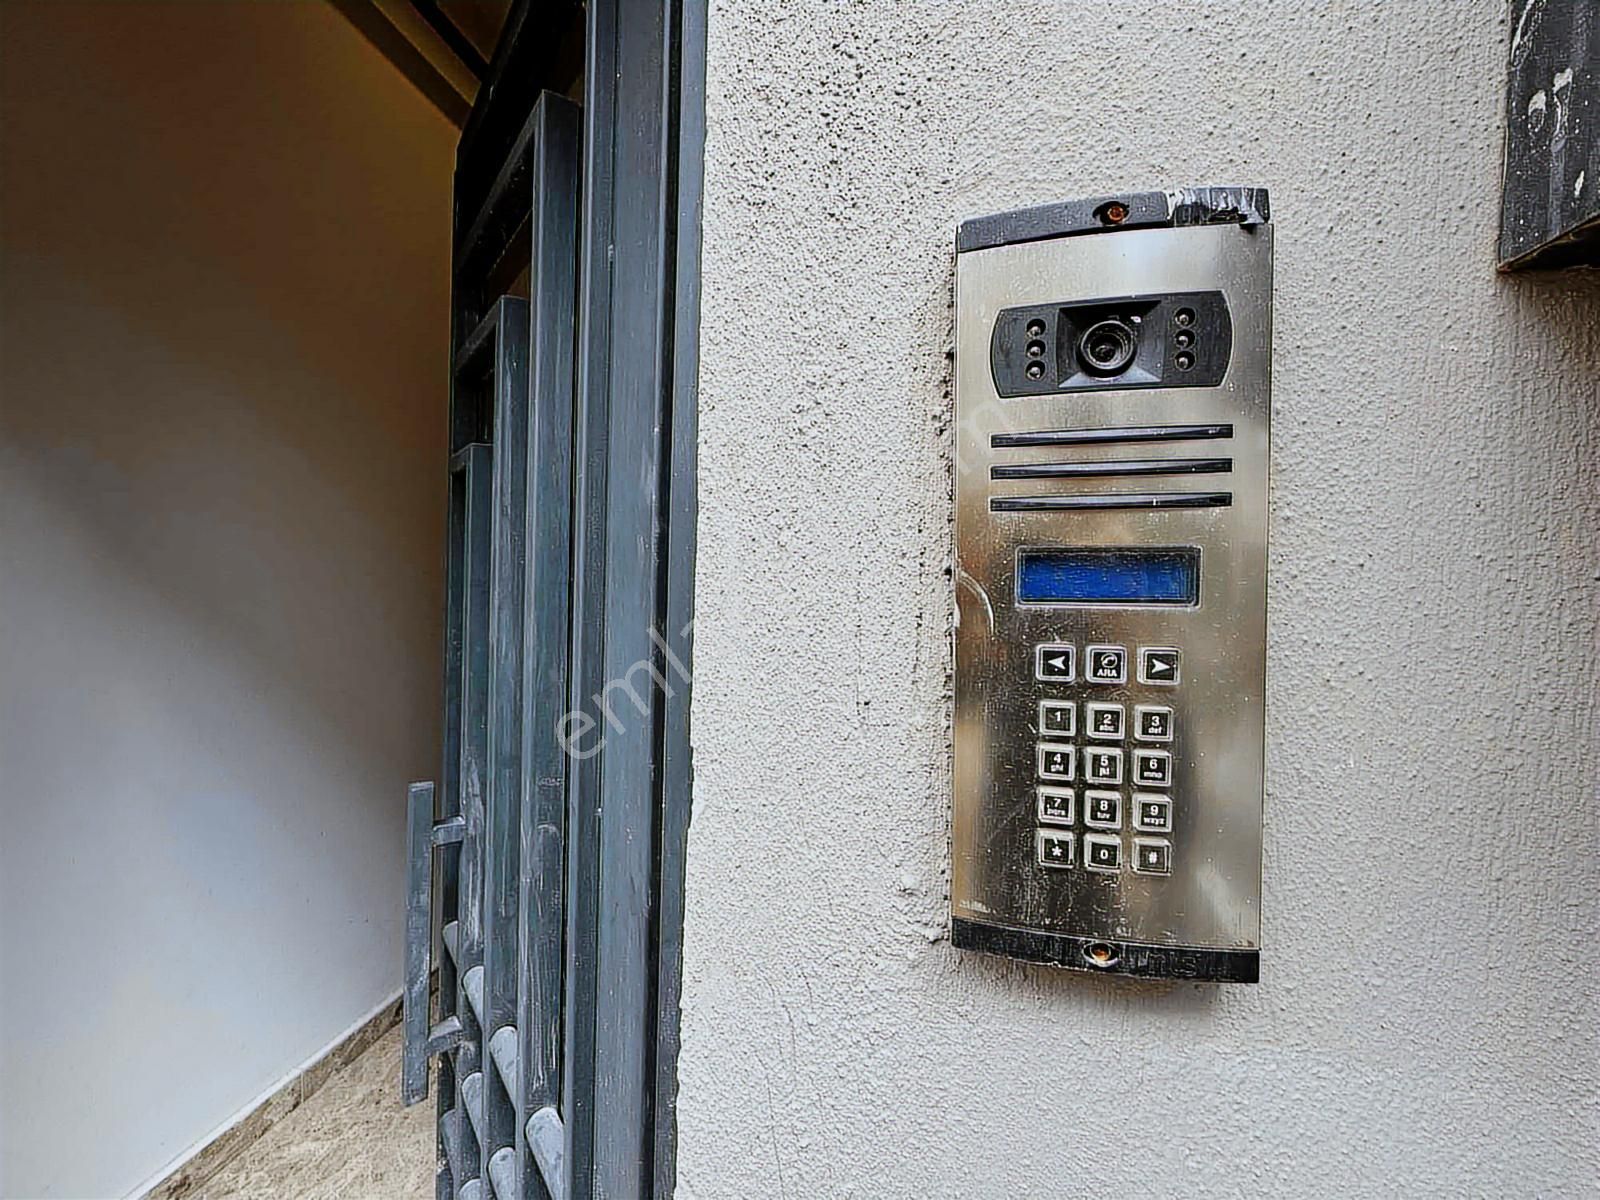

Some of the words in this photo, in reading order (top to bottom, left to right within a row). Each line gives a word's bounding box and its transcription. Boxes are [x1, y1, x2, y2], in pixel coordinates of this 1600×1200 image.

[1054, 710, 1061, 722] 1
[1103, 713, 1112, 724] 2
[1151, 715, 1160, 727] 3
[1053, 753, 1061, 764] 4
[1100, 755, 1109, 766] 5
[1149, 758, 1158, 769] 6
[1053, 798, 1062, 808] 7
[1100, 800, 1108, 811] 8
[1150, 805, 1159, 816] 9
[1100, 849, 1108, 860] 0
